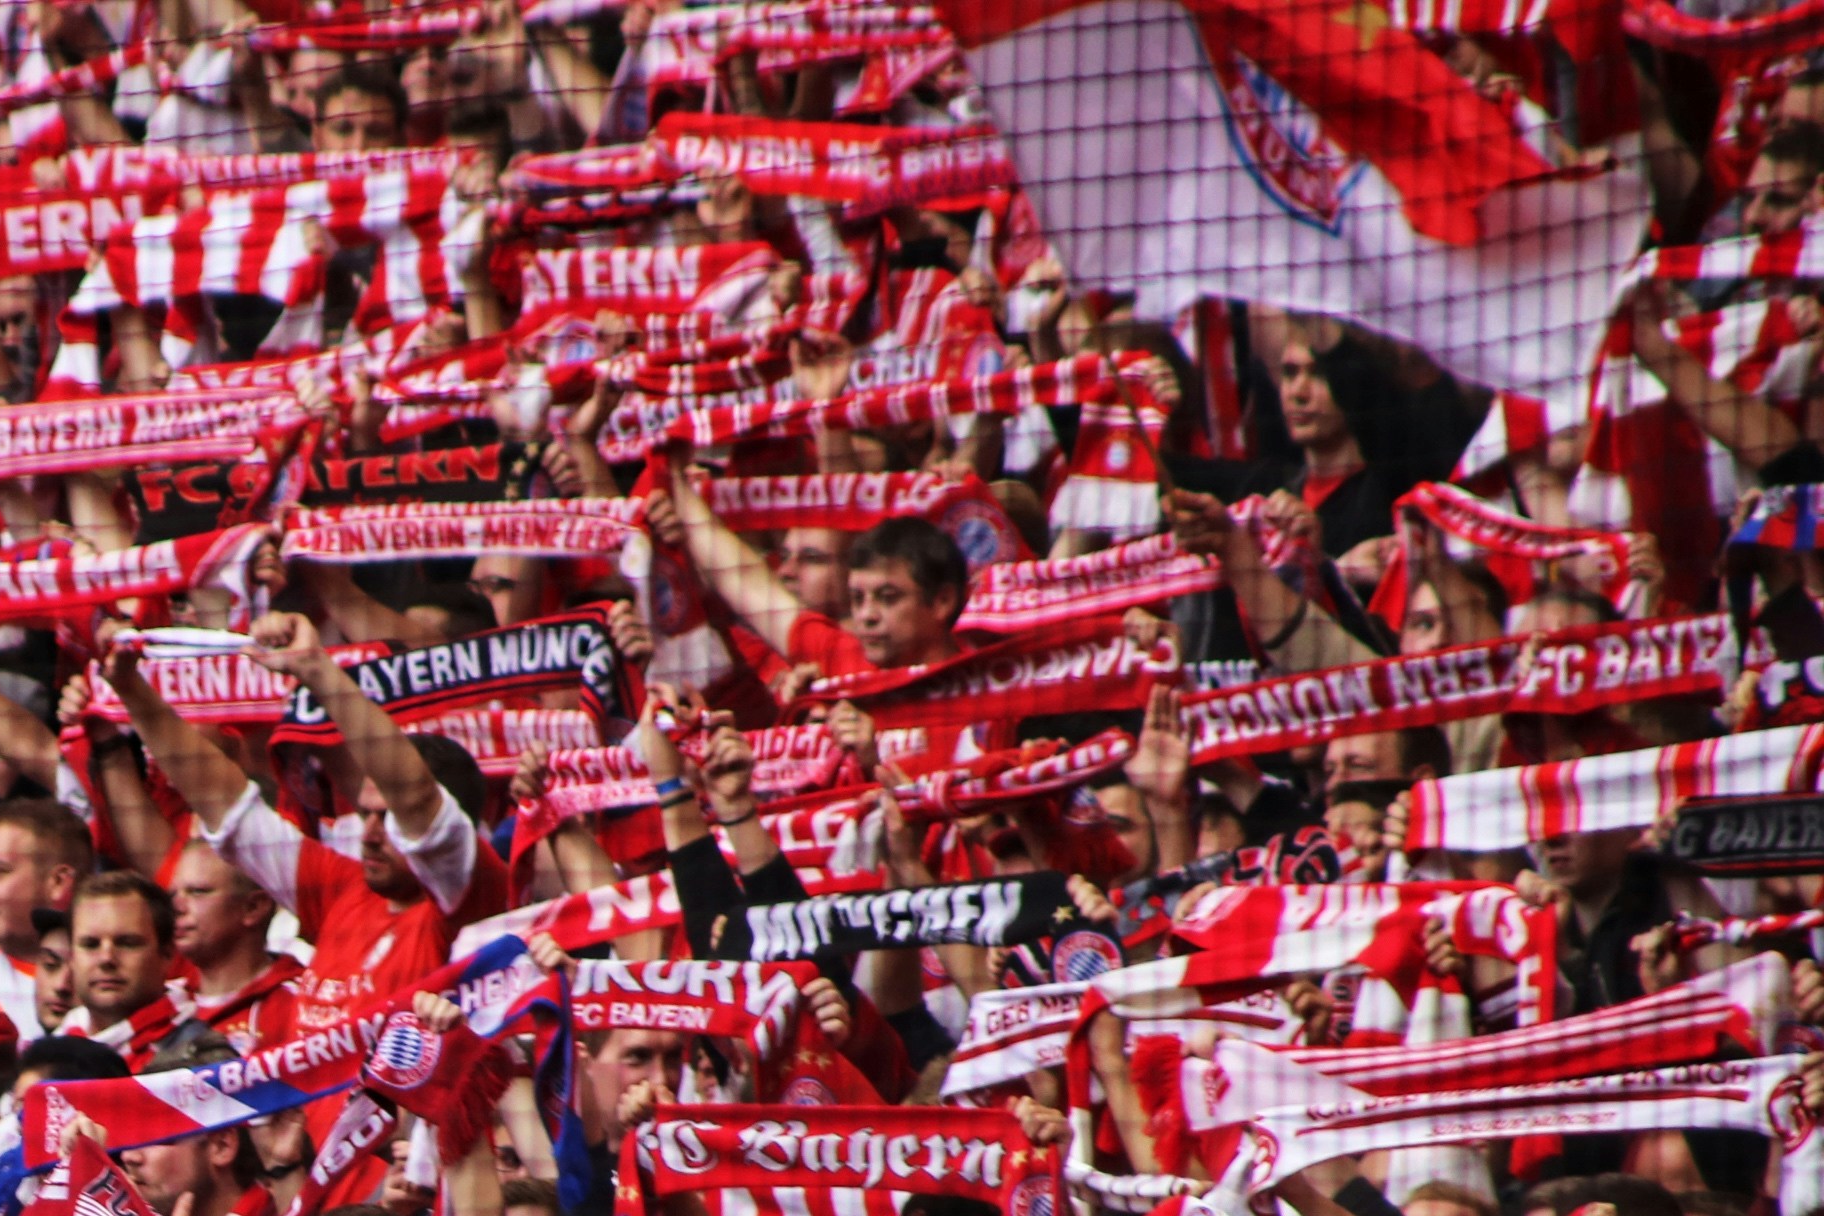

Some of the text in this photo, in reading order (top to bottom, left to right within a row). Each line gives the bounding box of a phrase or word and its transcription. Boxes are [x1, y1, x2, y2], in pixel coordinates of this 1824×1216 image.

[79, 539, 182, 595] MIA
[604, 1003, 713, 1030] BAYERN
[220, 1025, 357, 1096] BAYERN
[737, 1117, 1005, 1189] Bayern
